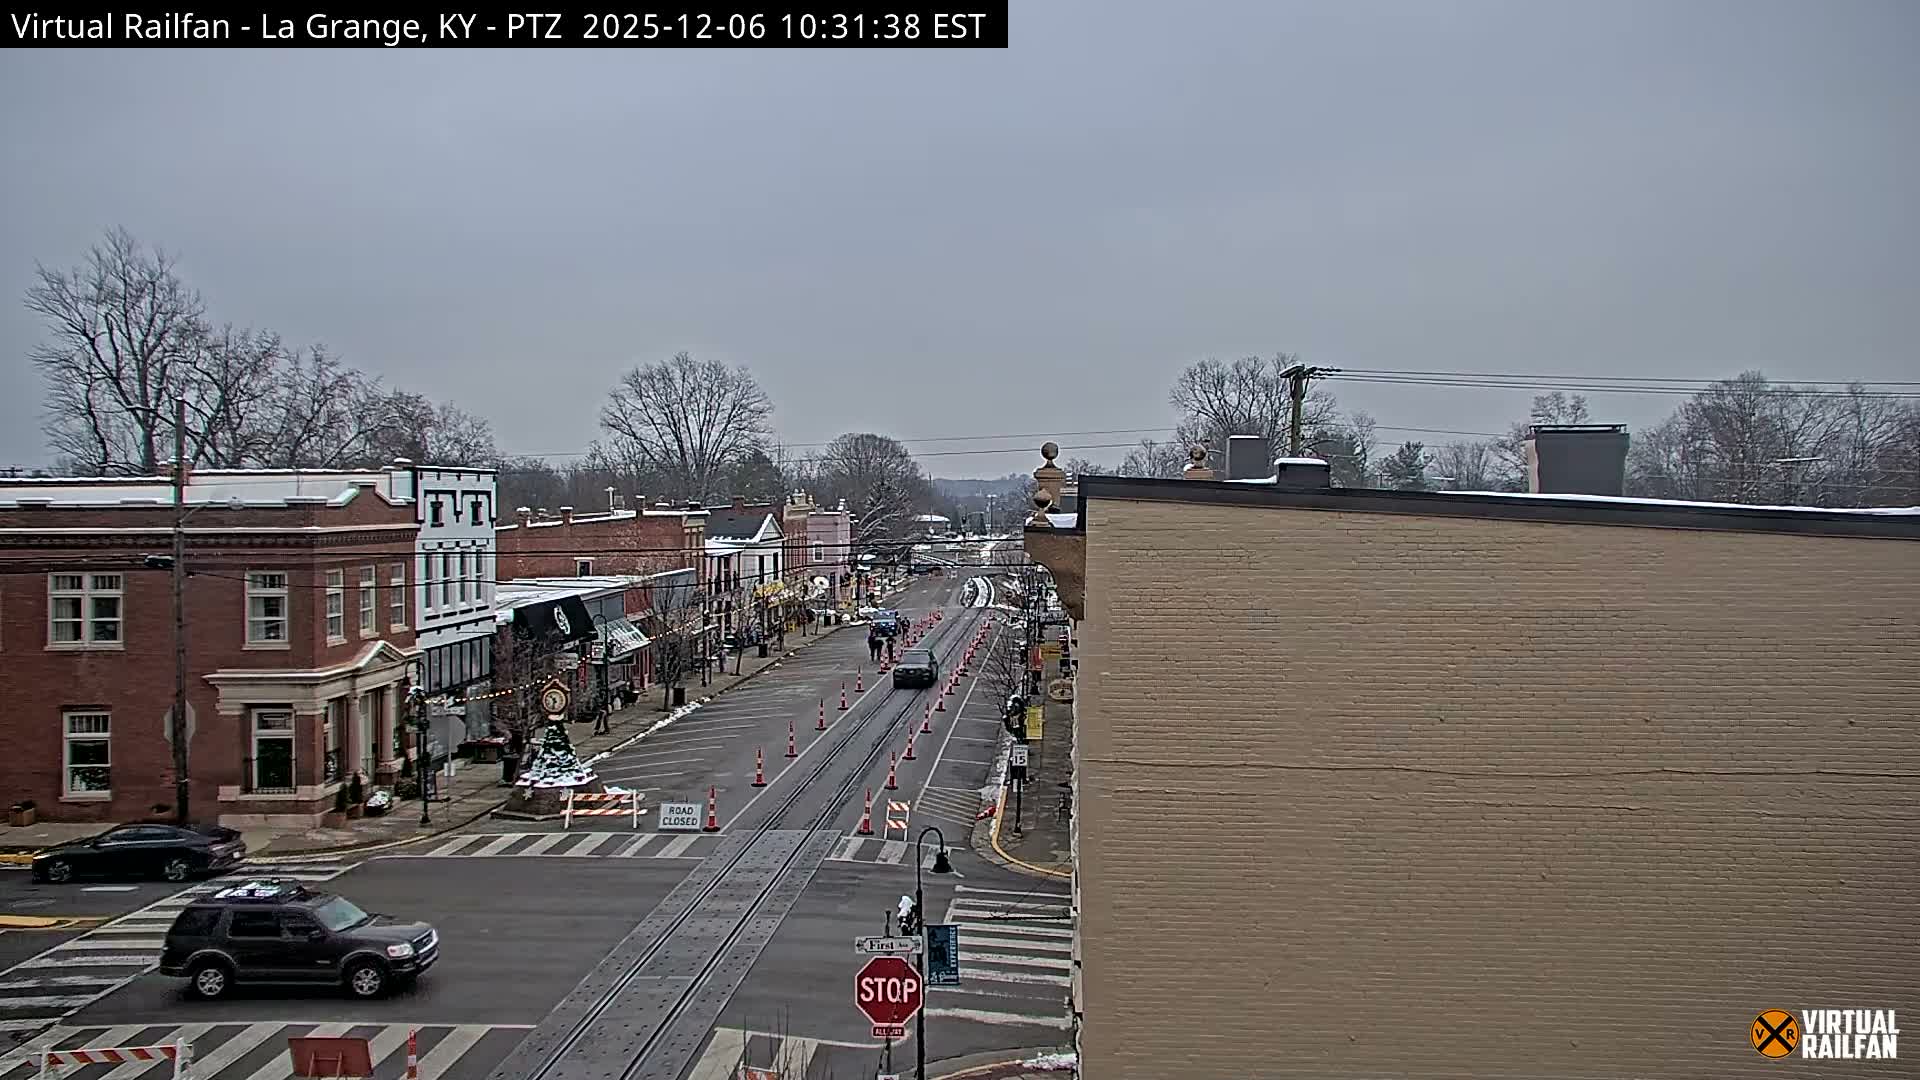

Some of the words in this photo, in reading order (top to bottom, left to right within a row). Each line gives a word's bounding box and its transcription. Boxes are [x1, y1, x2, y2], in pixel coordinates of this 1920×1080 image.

[1015, 755, 1026, 764] 15
[669, 806, 694, 815] ROAD
[662, 816, 698, 826] CLOSED
[869, 940, 895, 950] First
[860, 977, 918, 1003] STOP
